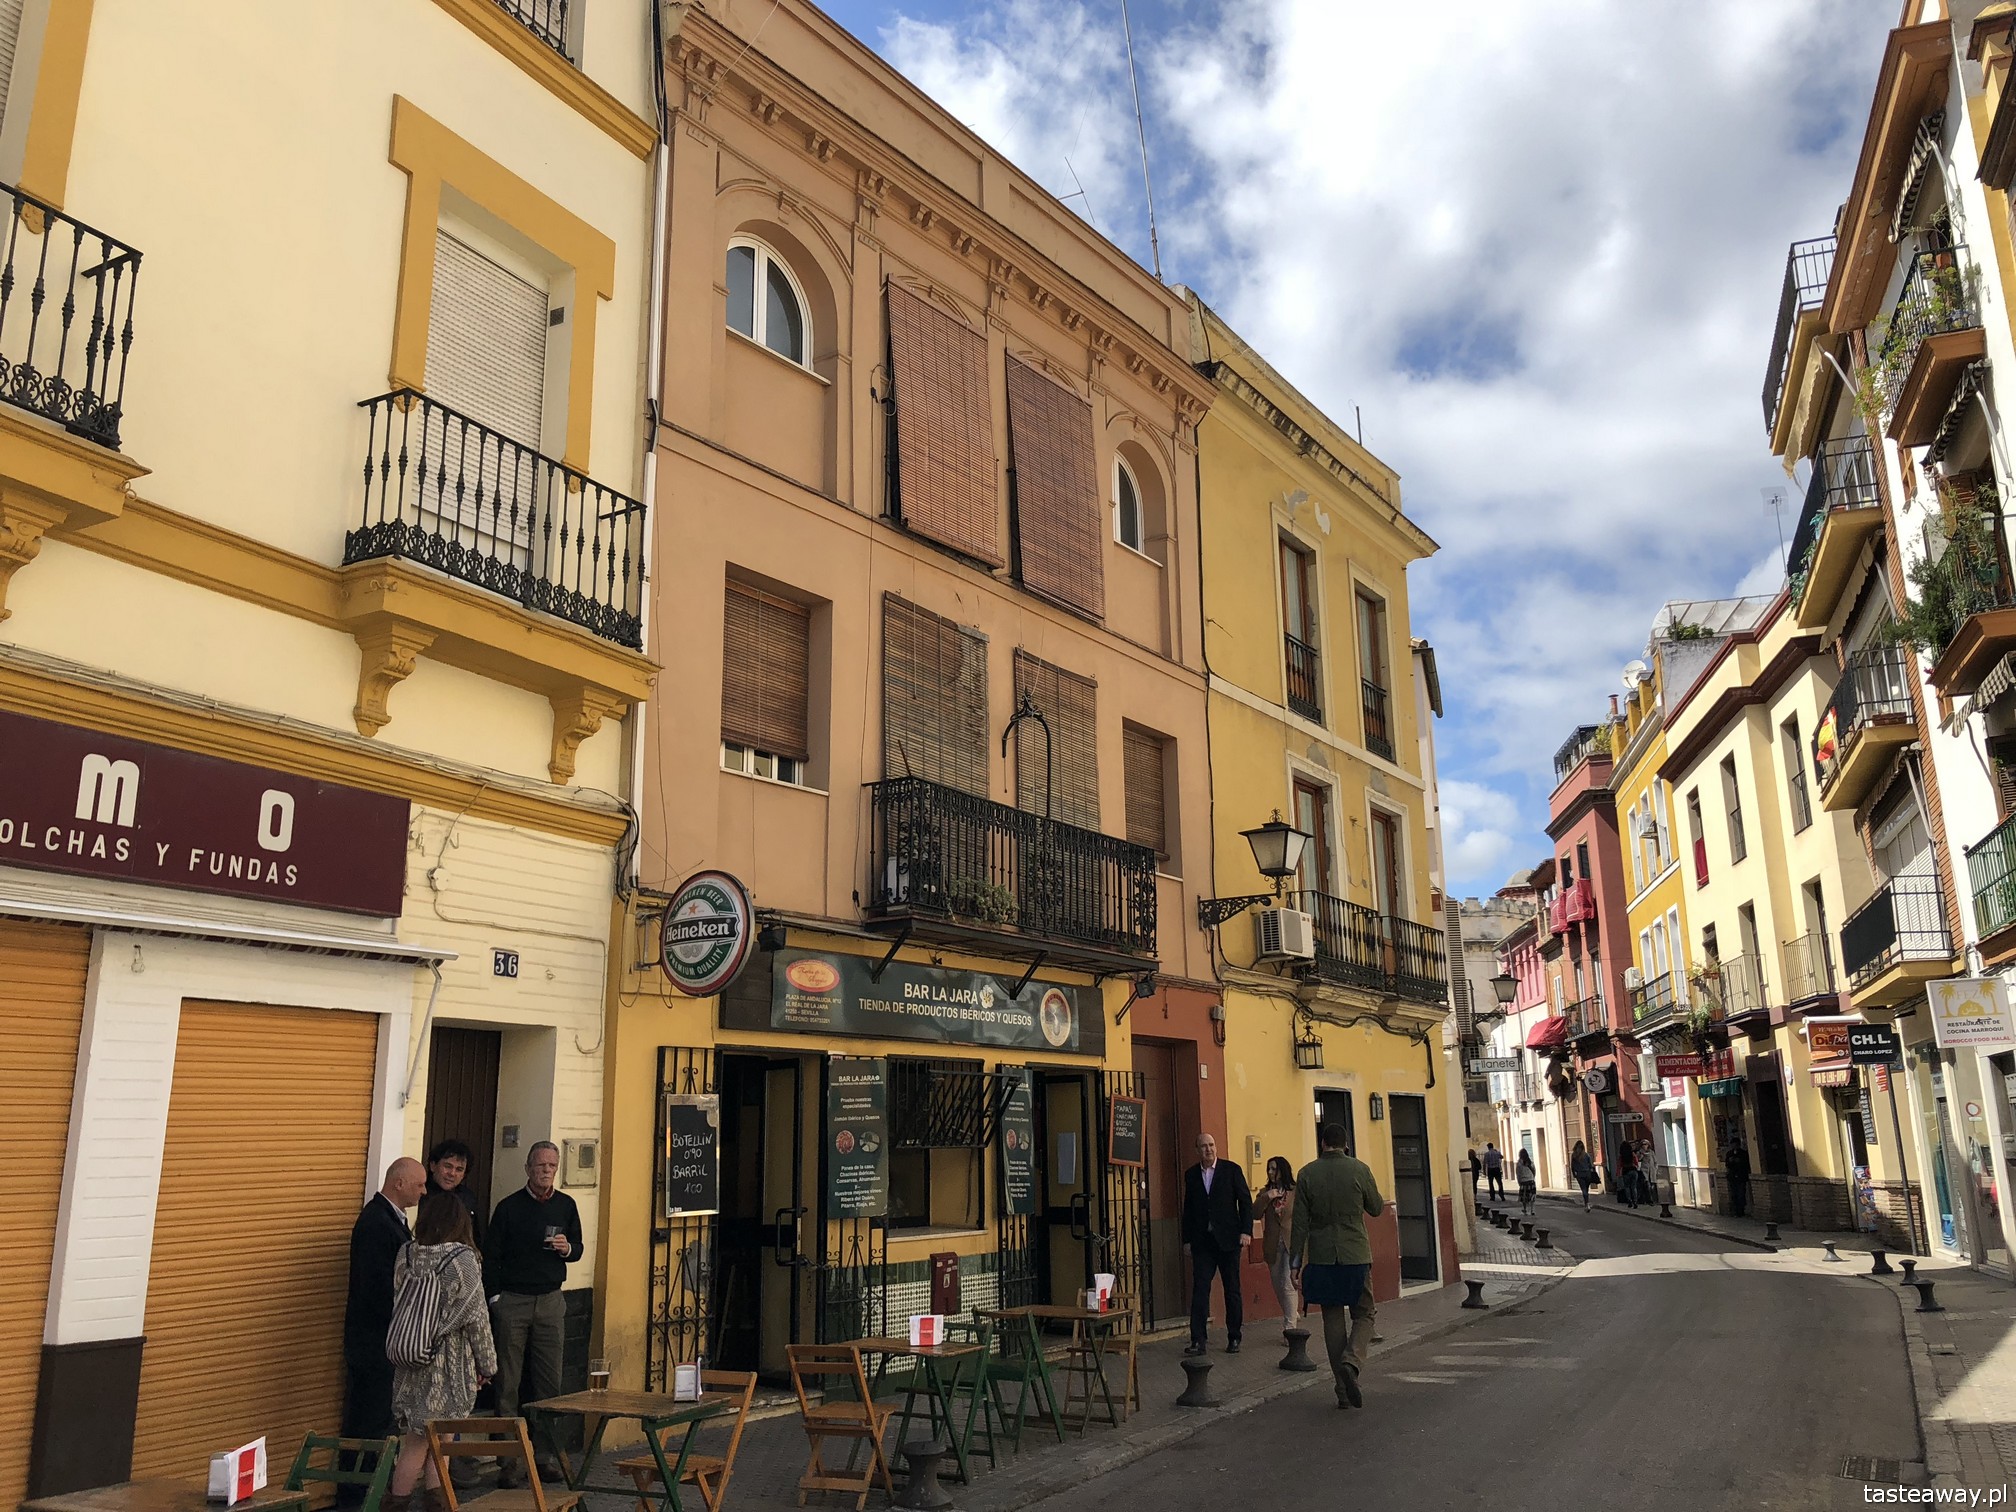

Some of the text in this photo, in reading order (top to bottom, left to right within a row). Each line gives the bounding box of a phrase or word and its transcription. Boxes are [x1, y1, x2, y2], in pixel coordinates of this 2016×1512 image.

[0, 818, 298, 887] OLCHAS Y FUNDAS
[674, 887, 724, 912] HEINEKEN BEER
[666, 921, 730, 943] Heineken
[495, 953, 518, 976] 36
[669, 947, 723, 976] PREMIUM QUALITY
[904, 982, 979, 1005] BAR LA JARA
[859, 998, 1032, 1026] TIENDA DE PRODUCTOS IBÉRICOS Y QUESOS
[1947, 1020, 1991, 1028] RESTAURANTE
[1664, 1067, 1675, 1075] San
[1116, 1105, 1132, 1114] TAPAS
